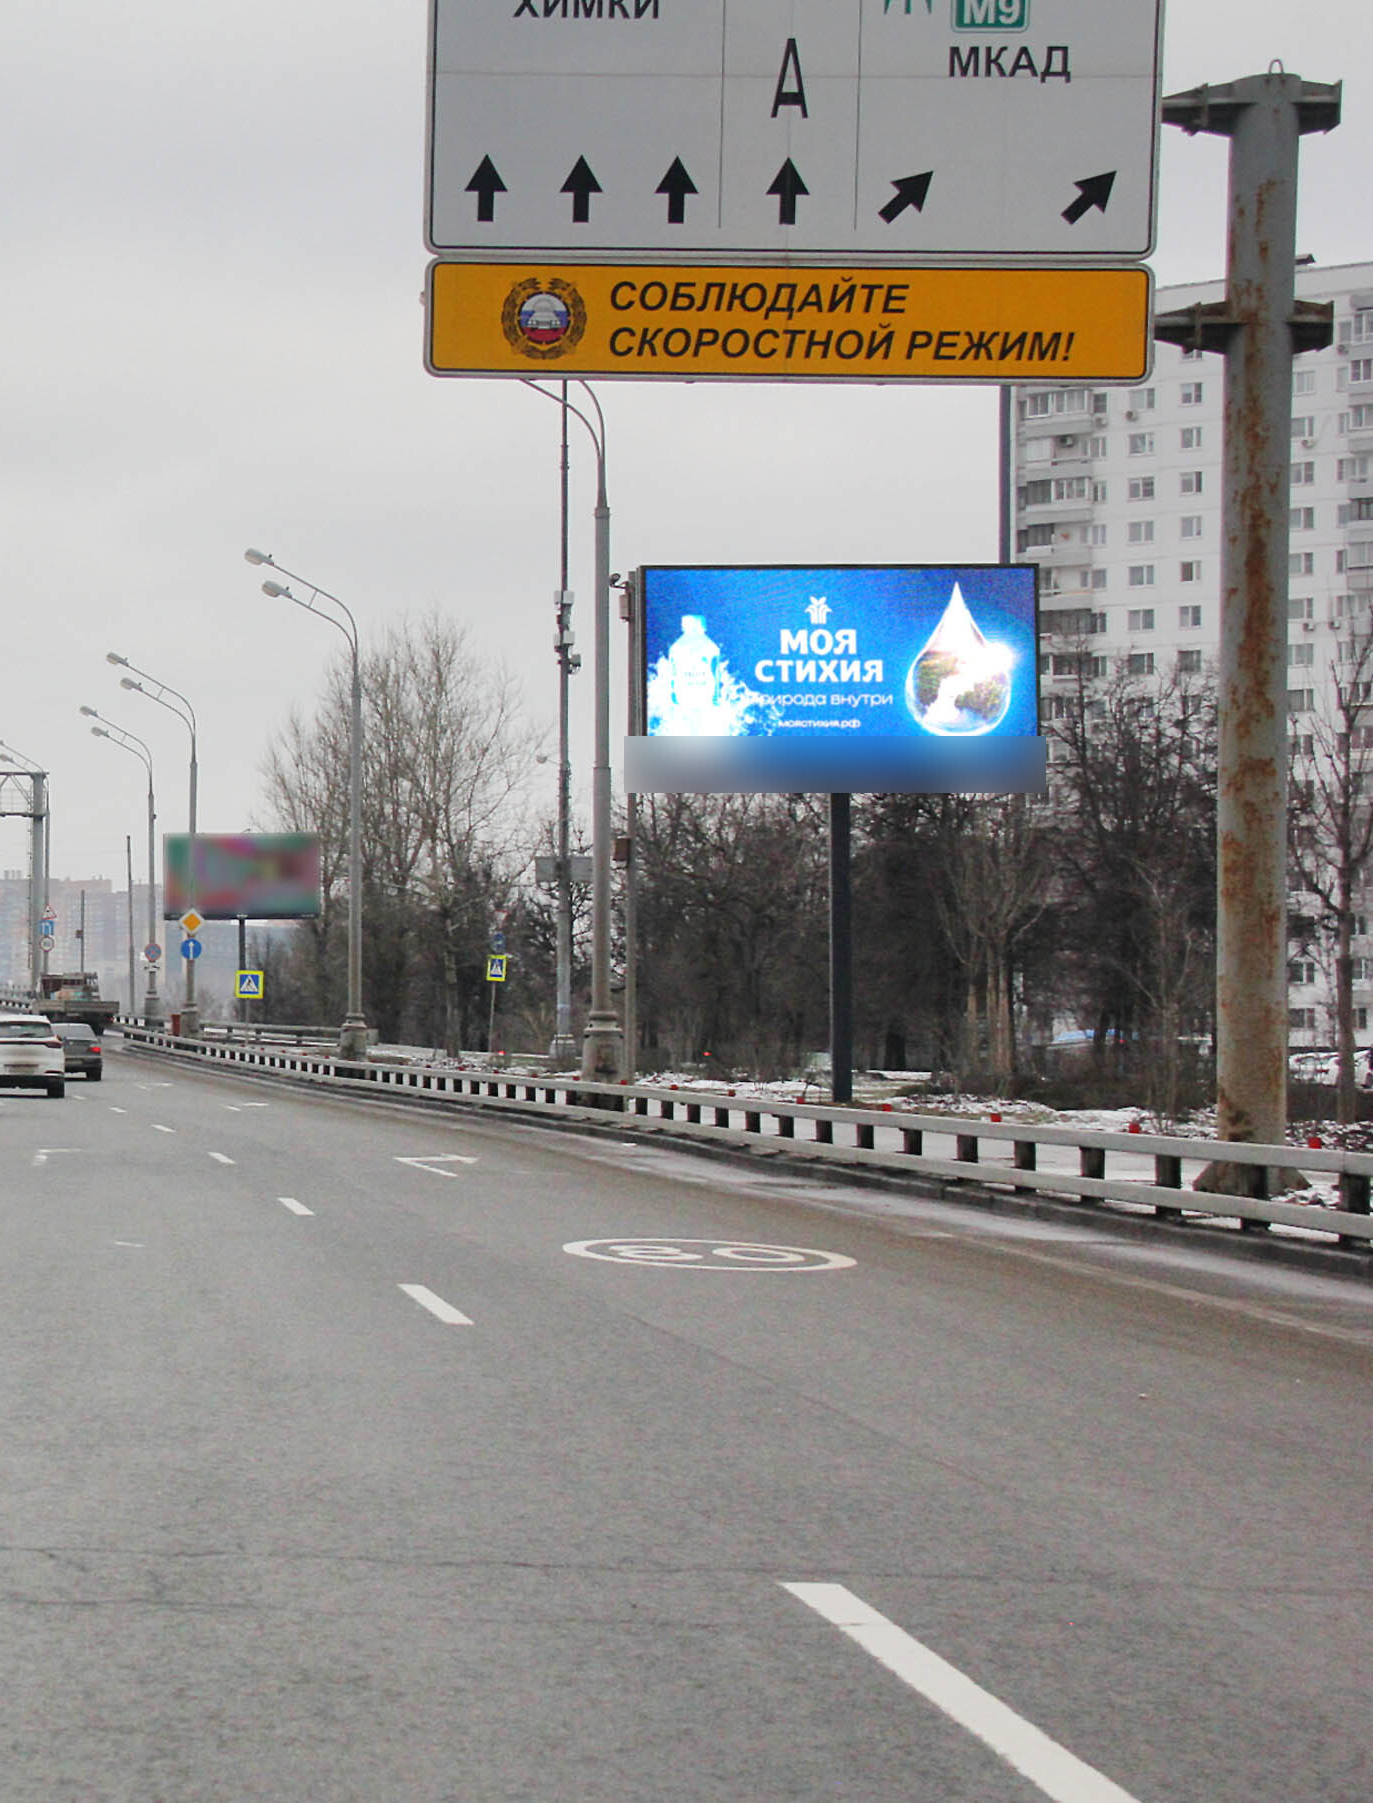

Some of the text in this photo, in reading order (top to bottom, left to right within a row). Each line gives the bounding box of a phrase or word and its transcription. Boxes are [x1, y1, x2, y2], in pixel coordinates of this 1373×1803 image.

[963, 0, 1020, 25] М9
[948, 46, 1071, 83] МКАД
[610, 276, 910, 320] СОБЛЮДАЙТЕ
[609, 323, 1076, 361] СКОРОСТНОЙ РЕЖИМ!
[779, 629, 857, 655] МОЯ
[754, 659, 884, 683] СТИХИЯ
[830, 693, 894, 708] внутри
